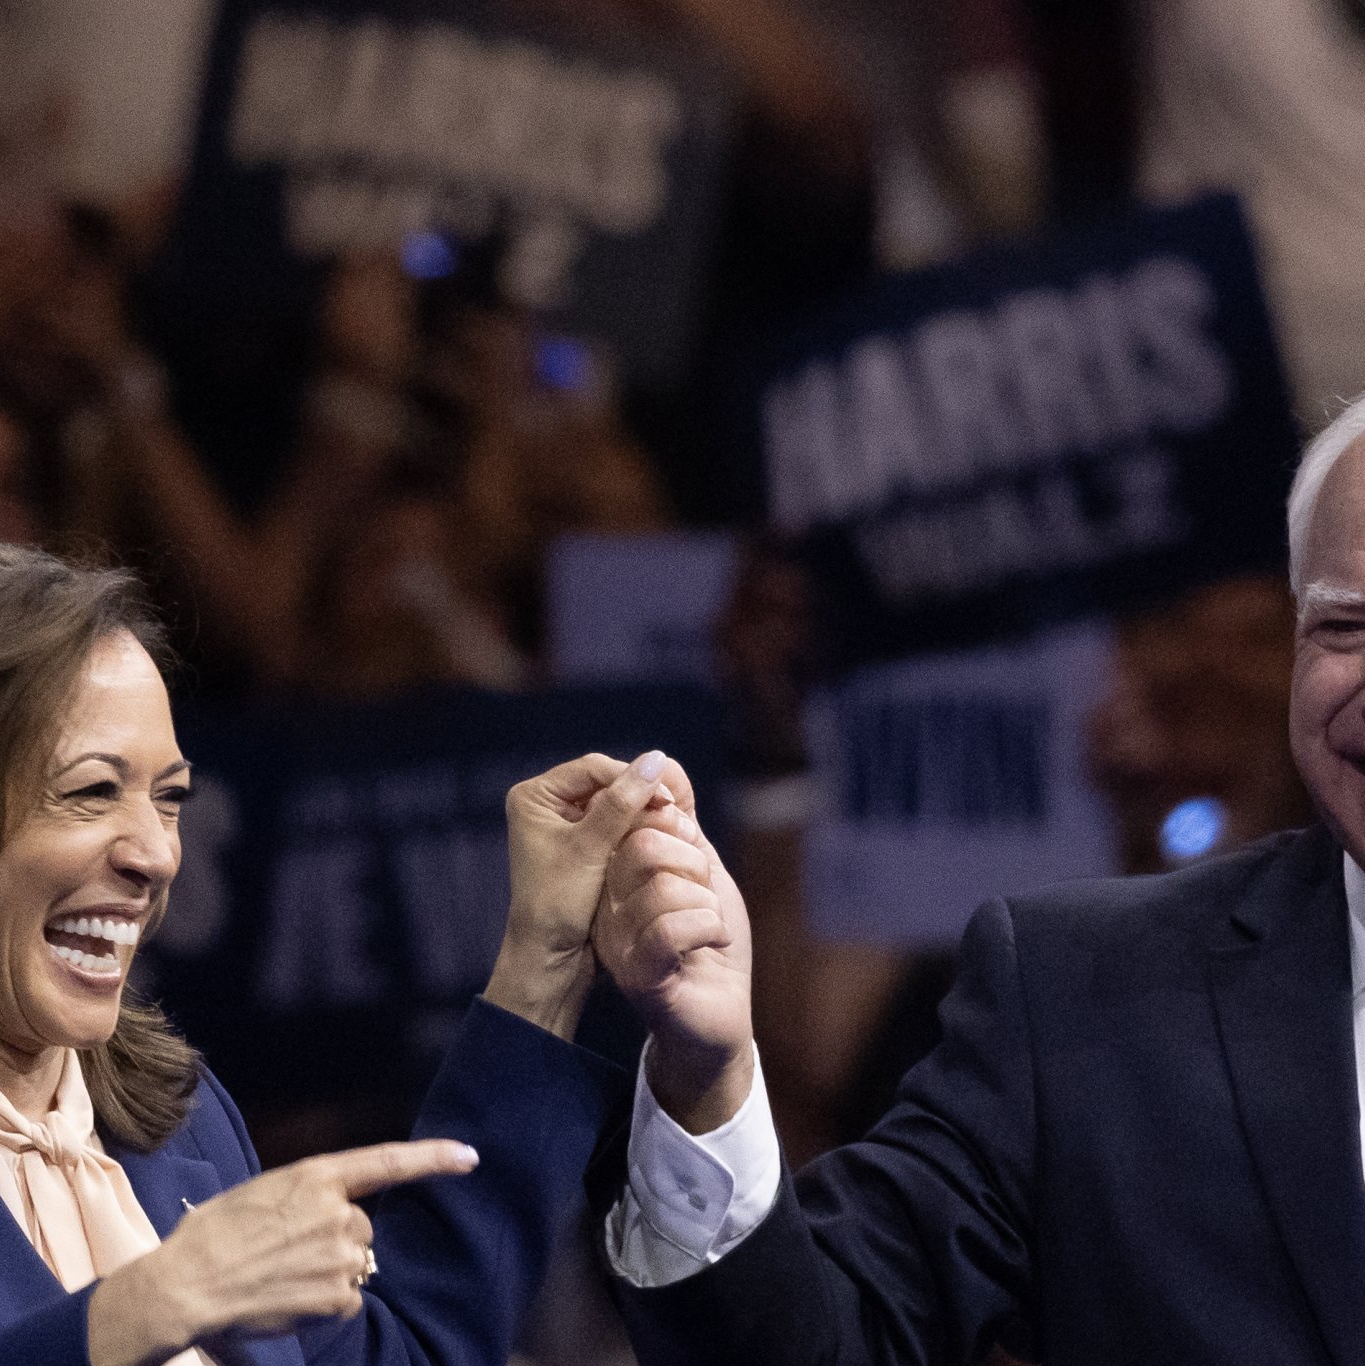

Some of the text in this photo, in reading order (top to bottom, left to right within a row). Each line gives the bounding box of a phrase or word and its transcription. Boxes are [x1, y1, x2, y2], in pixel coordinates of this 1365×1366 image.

[230, 8, 681, 236] HARRIS
[283, 175, 583, 306] WAZ
[765, 253, 1237, 540] HARRIS
[850, 450, 1193, 610] WALZ
[845, 698, 1049, 834] WIN
